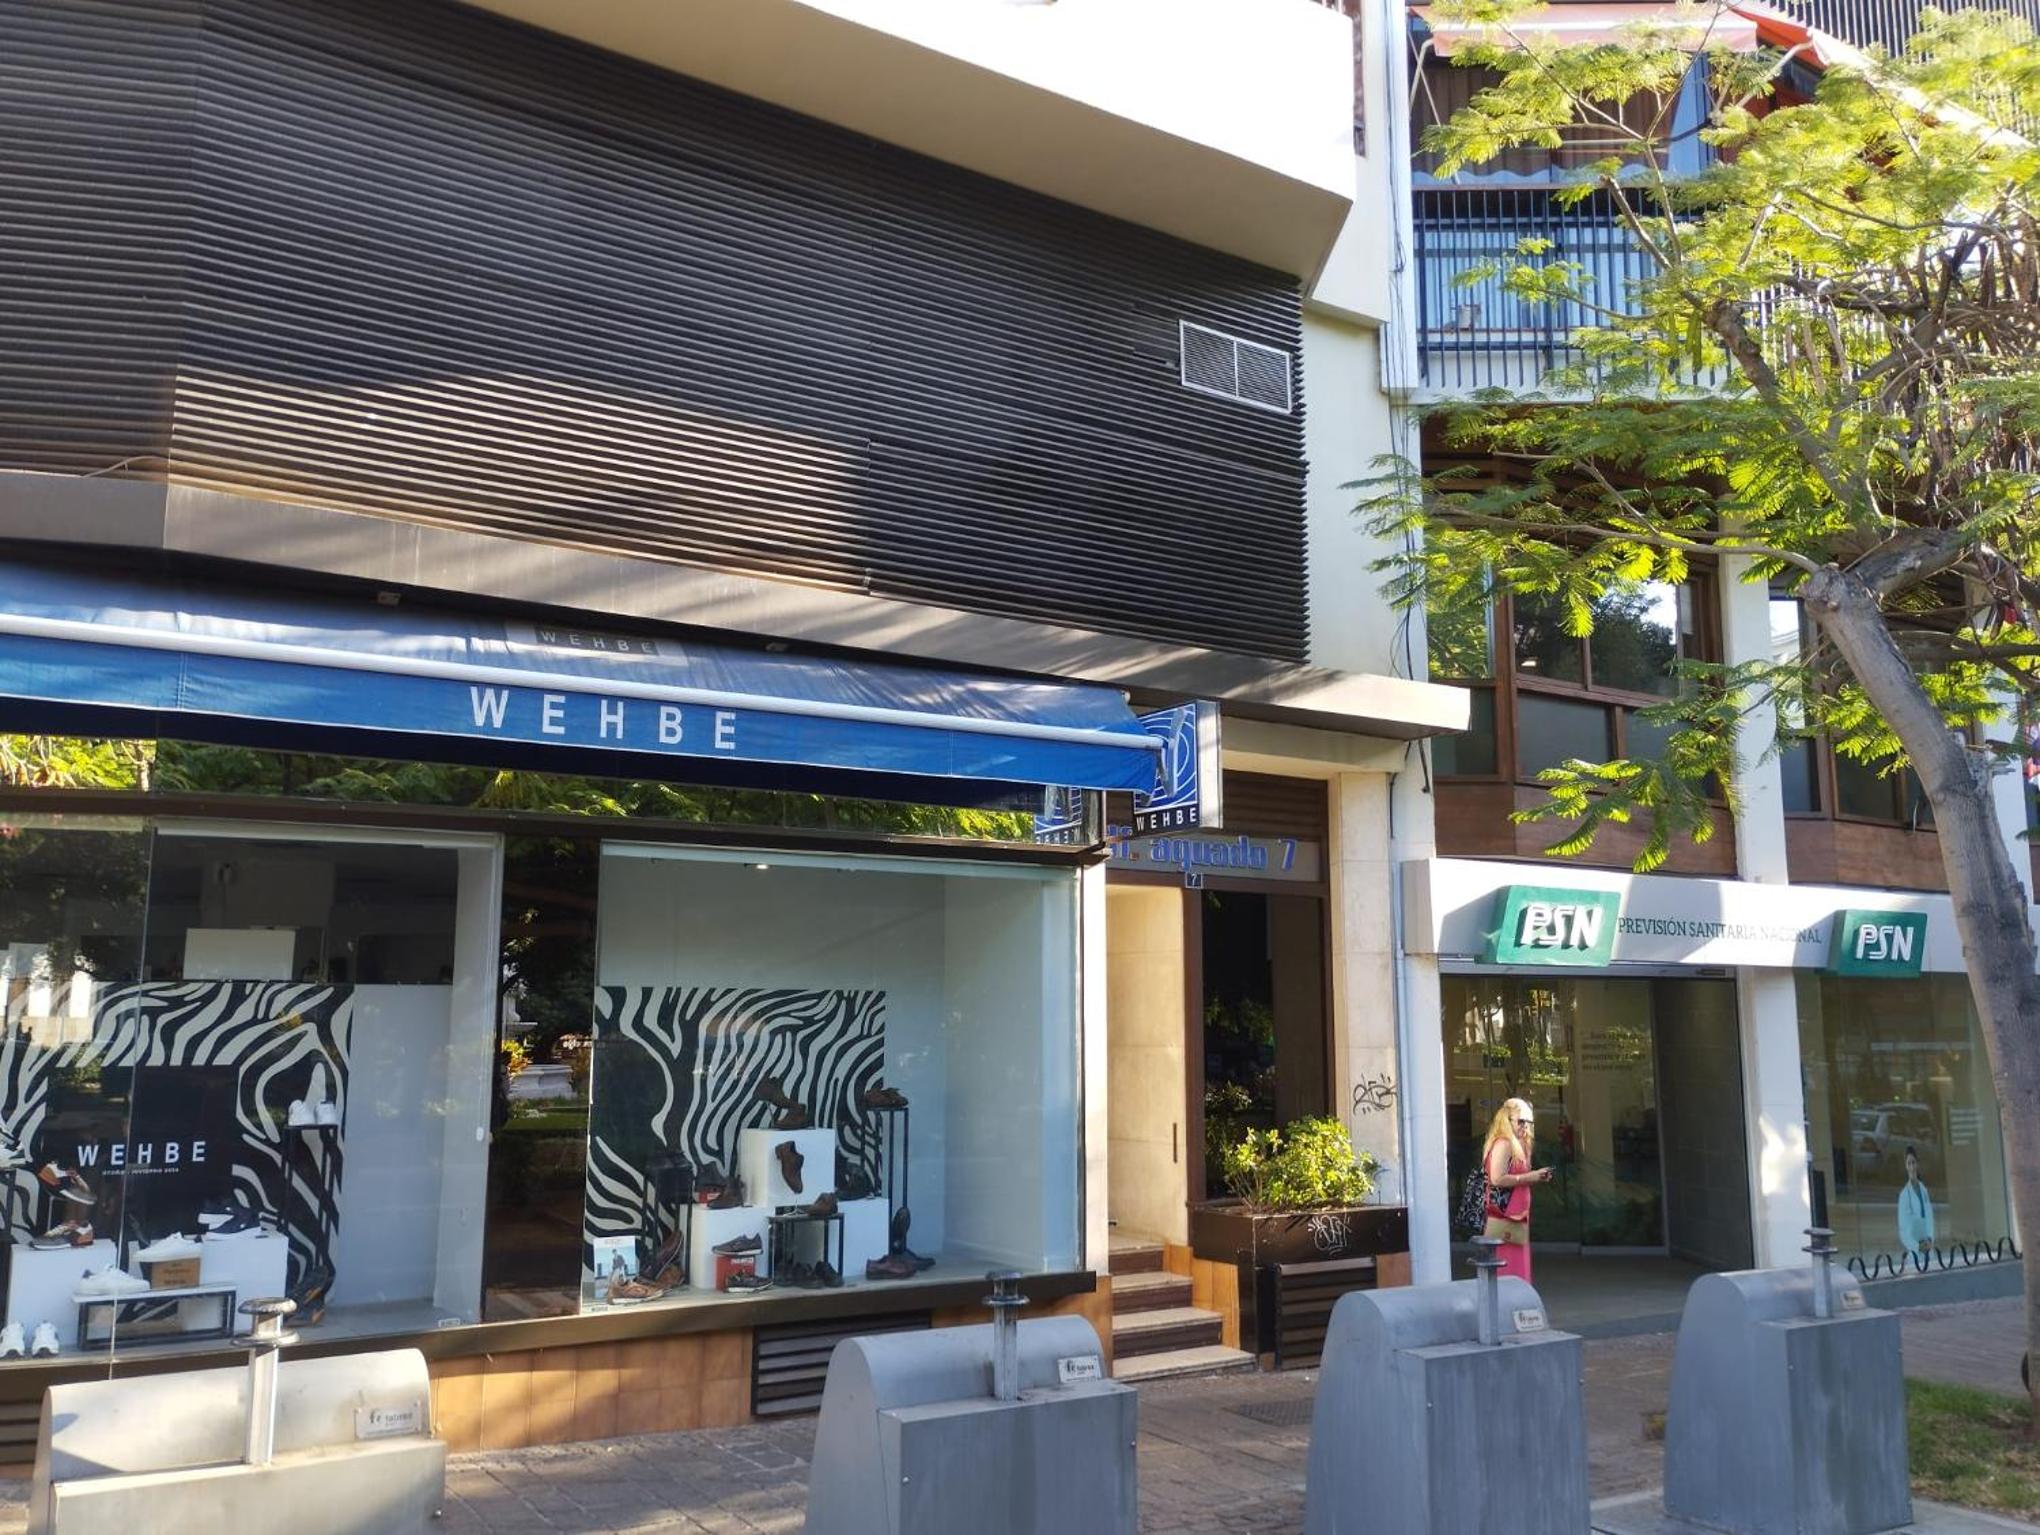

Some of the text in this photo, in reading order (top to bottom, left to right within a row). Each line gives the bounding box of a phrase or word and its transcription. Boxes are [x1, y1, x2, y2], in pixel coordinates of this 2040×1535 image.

[541, 631, 654, 654] WEHBE
[470, 686, 736, 749] WEHBE
[1136, 807, 1197, 832] WEHBE
[1278, 838, 1297, 872] 7
[1520, 902, 1605, 948] PSN
[1618, 917, 1687, 937] PREVISIÓN
[1689, 921, 1757, 941] SANITARIA
[1856, 924, 1914, 962] PSN
[77, 1140, 206, 1168] WEHBE
